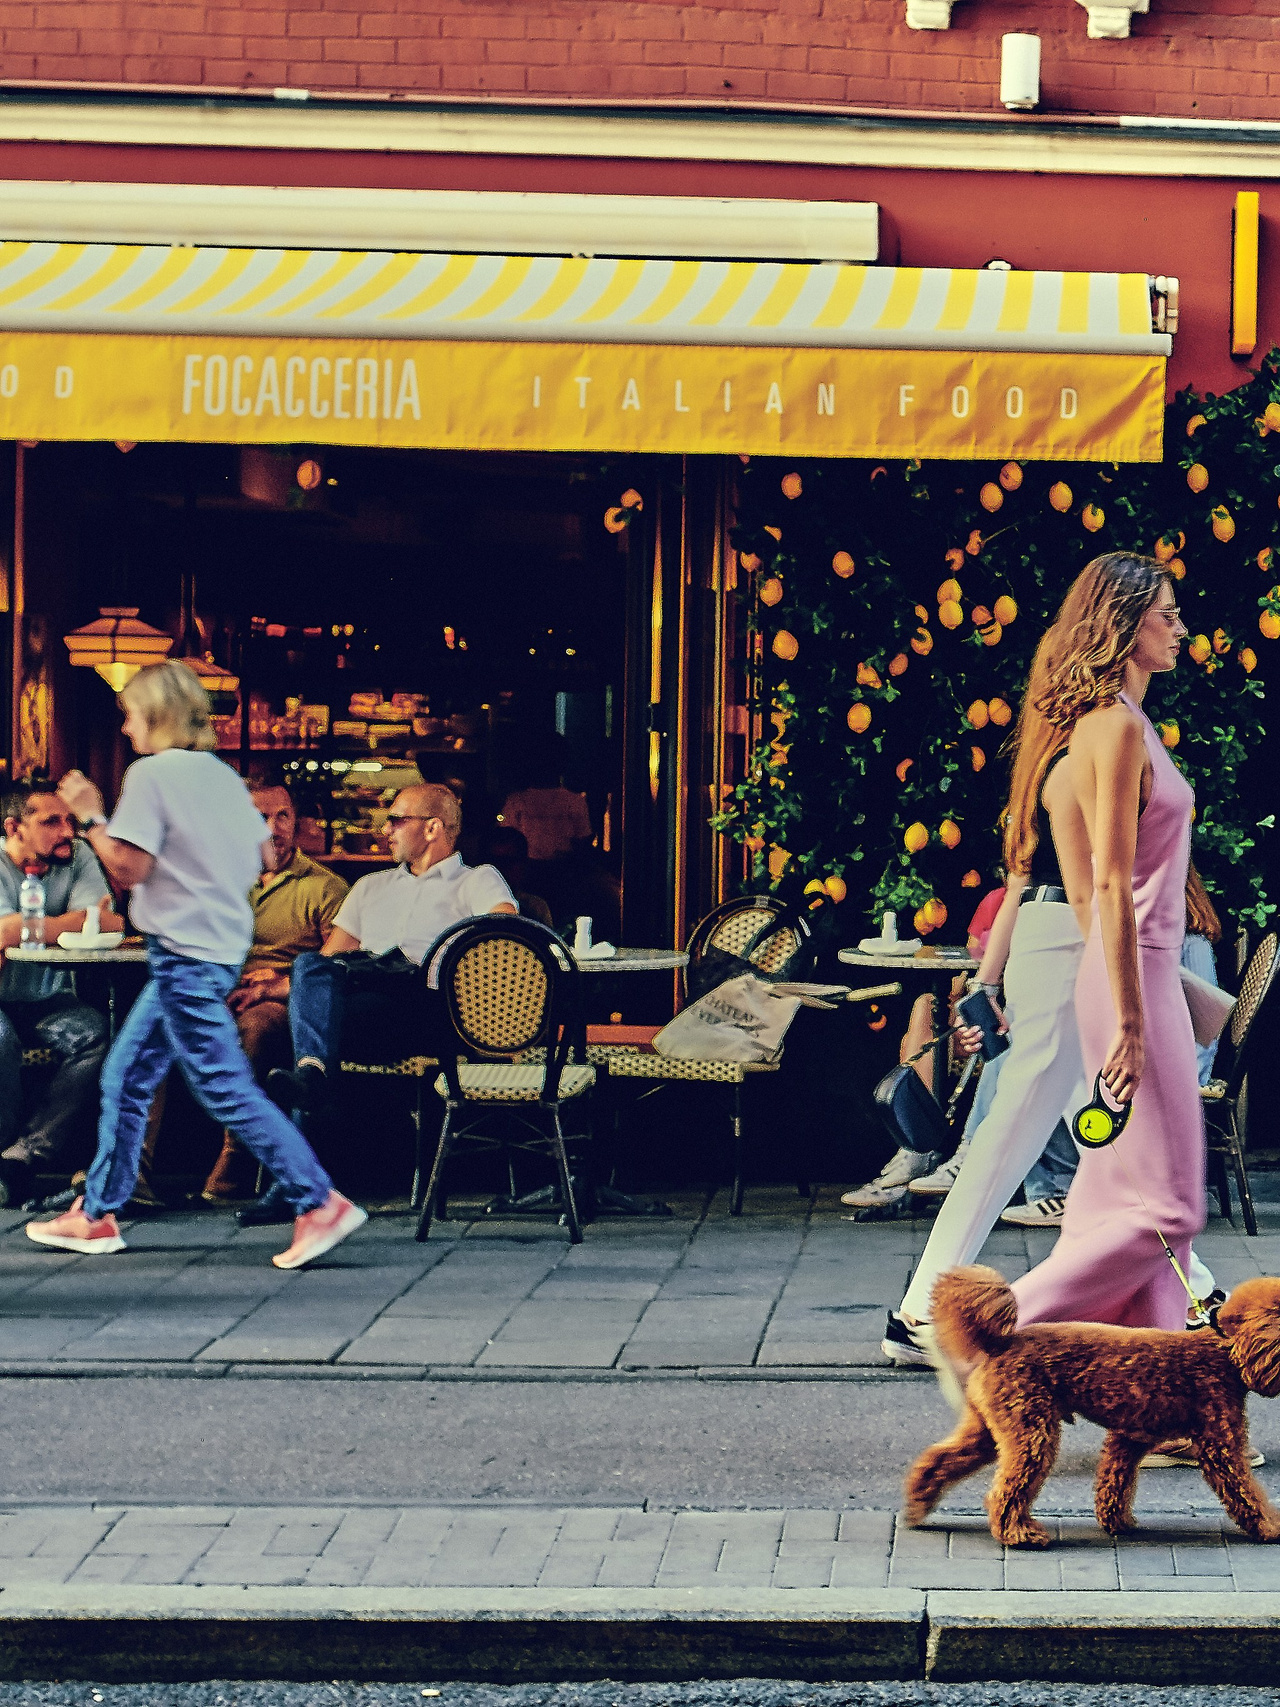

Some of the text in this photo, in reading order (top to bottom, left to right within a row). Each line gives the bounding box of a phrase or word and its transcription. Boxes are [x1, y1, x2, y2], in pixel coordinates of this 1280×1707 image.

[182, 354, 422, 421] FOCACCERIA
[533, 375, 835, 416] ITALIAN
[899, 384, 1078, 420] FOOD
